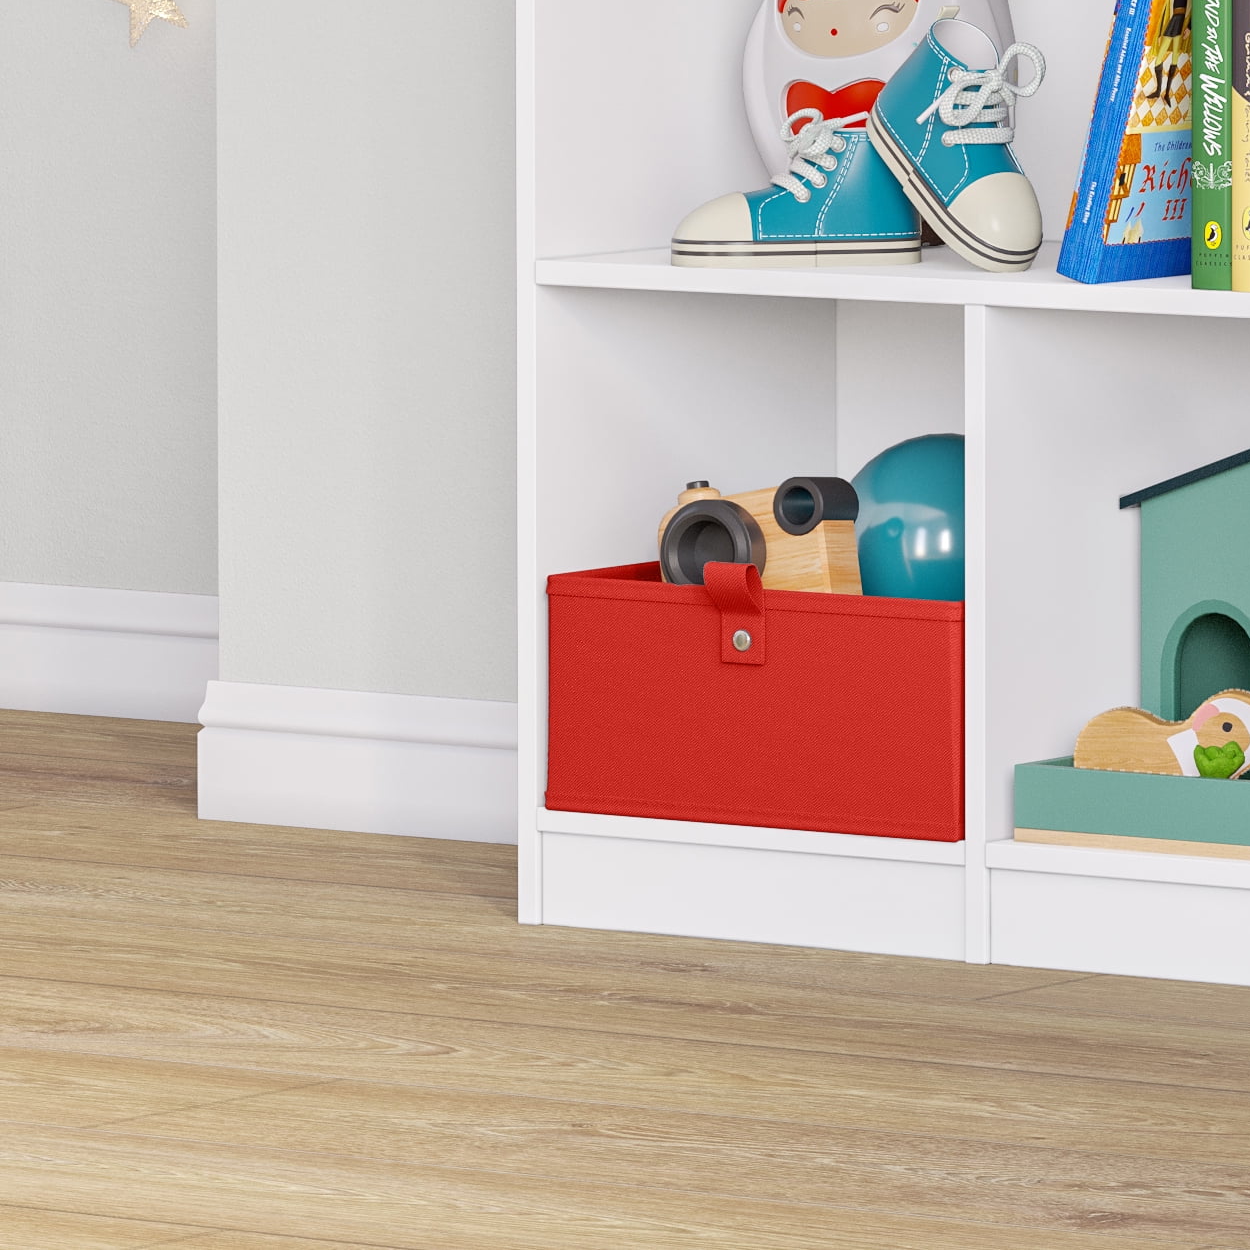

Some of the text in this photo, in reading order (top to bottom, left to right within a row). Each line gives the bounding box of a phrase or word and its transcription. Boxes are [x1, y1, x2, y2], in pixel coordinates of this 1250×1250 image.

[1206, 26, 1218, 44] IN
[1201, 42, 1224, 75] THE
[1199, 74, 1228, 157] WILLOWS
[1154, 142, 1165, 152] The
[1139, 157, 1192, 194] Rich
[1162, 198, 1187, 220] III
